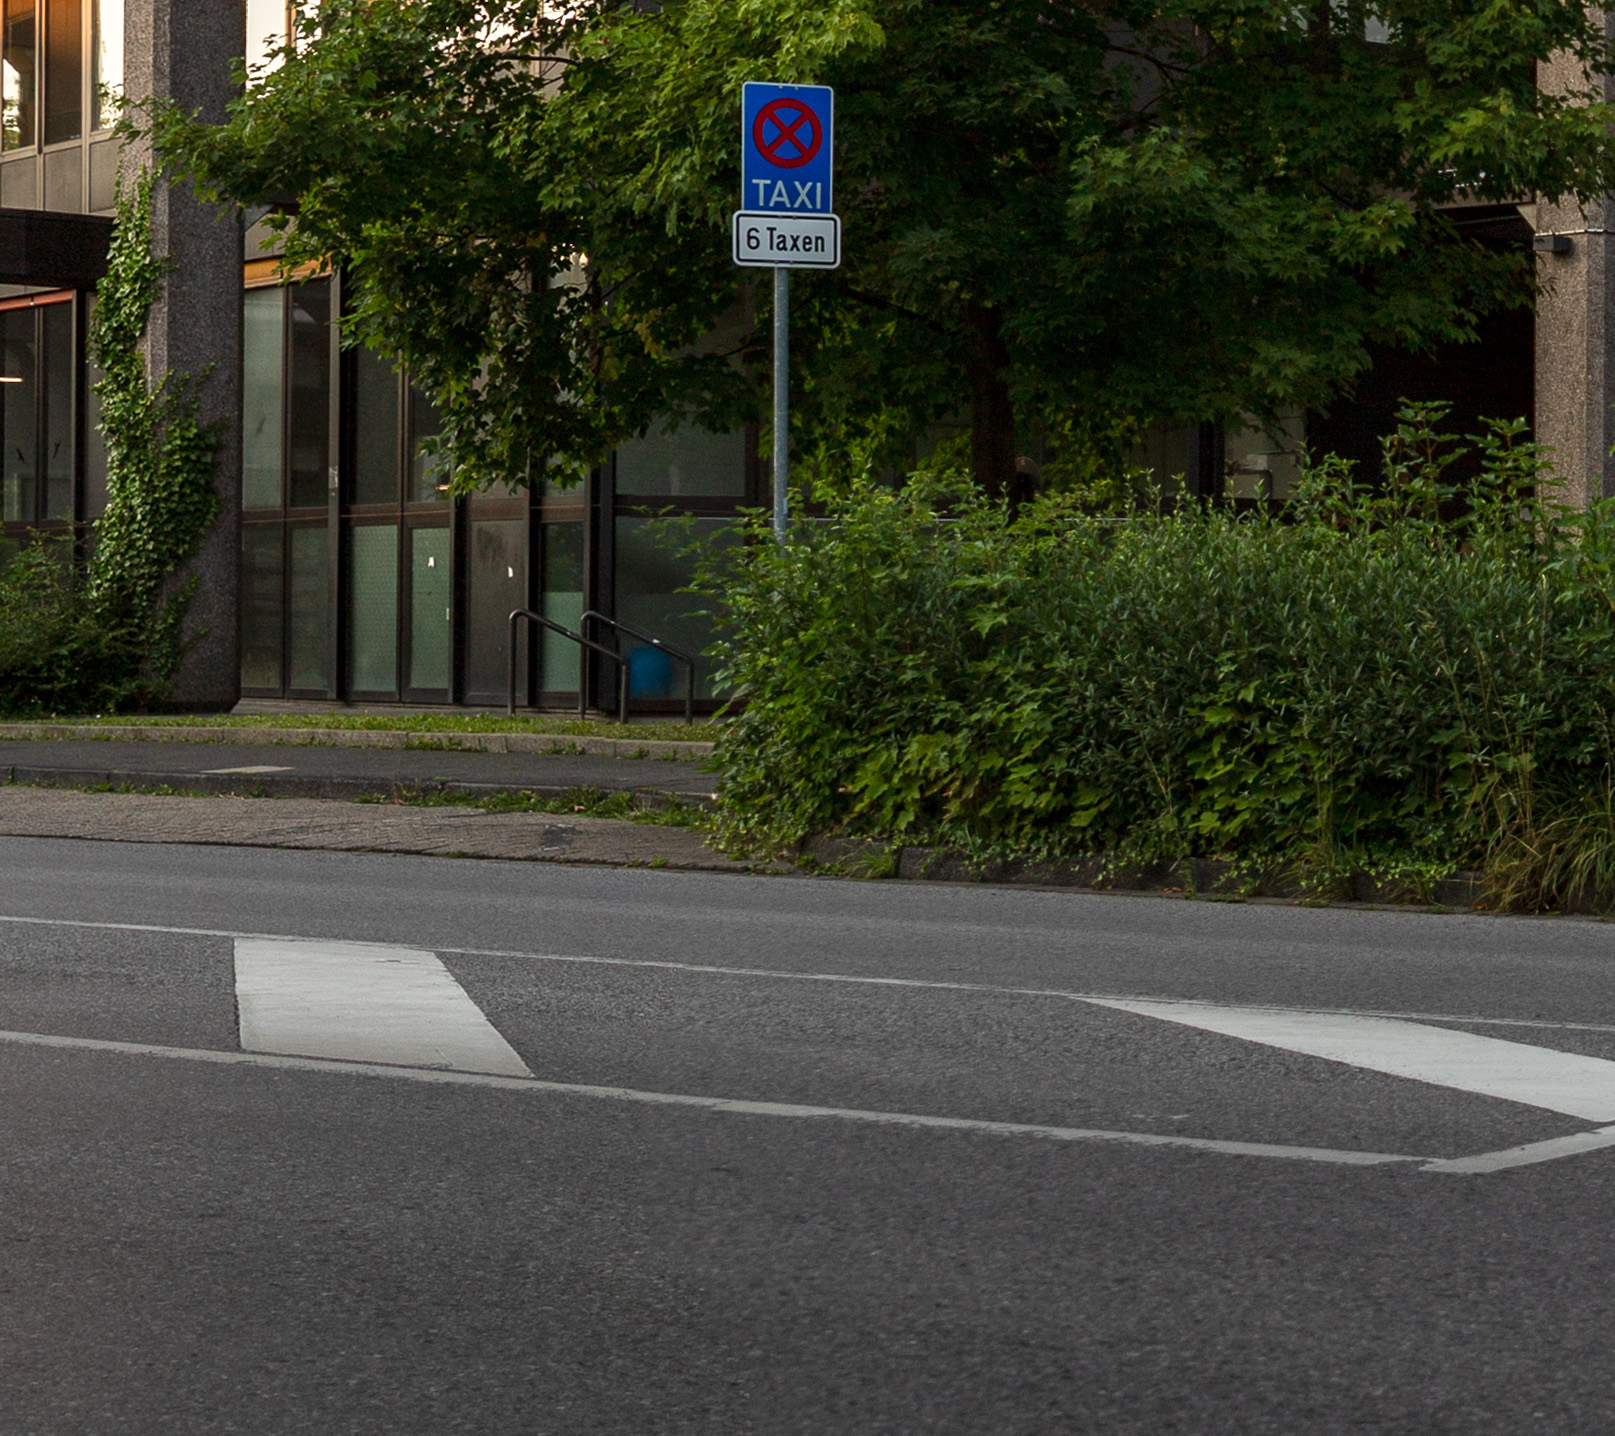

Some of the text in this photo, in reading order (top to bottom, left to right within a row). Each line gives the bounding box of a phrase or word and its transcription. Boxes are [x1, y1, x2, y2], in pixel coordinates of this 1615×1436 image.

[751, 178, 822, 210] TAXI
[746, 226, 825, 253] 6 Taxen
